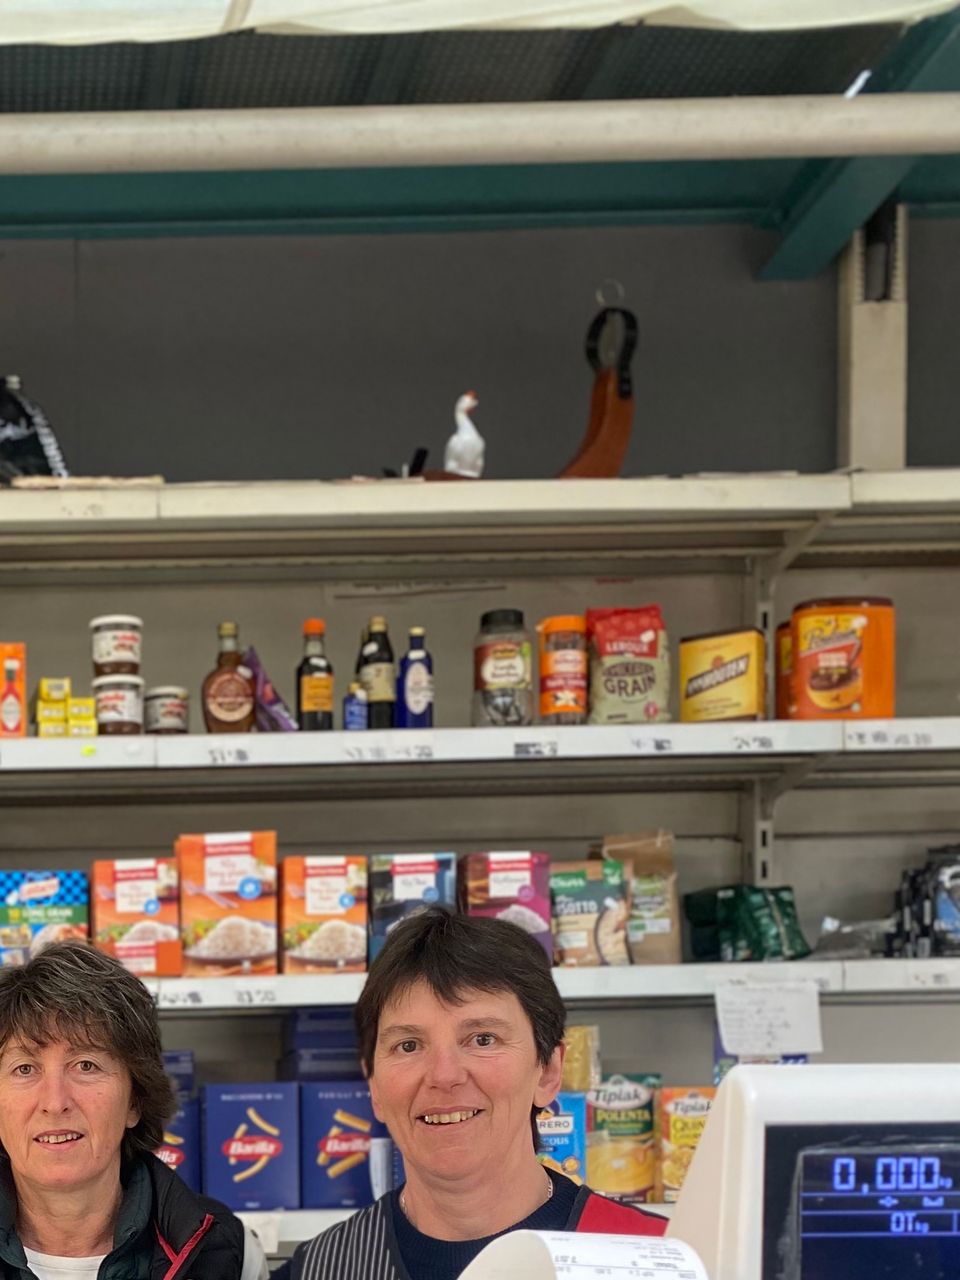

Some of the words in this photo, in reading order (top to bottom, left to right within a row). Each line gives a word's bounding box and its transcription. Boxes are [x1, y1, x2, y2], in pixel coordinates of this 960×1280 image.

[603, 675, 656, 697] GRAIN
[594, 1087, 643, 1102] Tipiak
[595, 1110, 651, 1121] POLENTA
[539, 1120, 570, 1128] RERO
[672, 1119, 706, 1132] QUIN
[229, 1140, 277, 1155] Barilla
